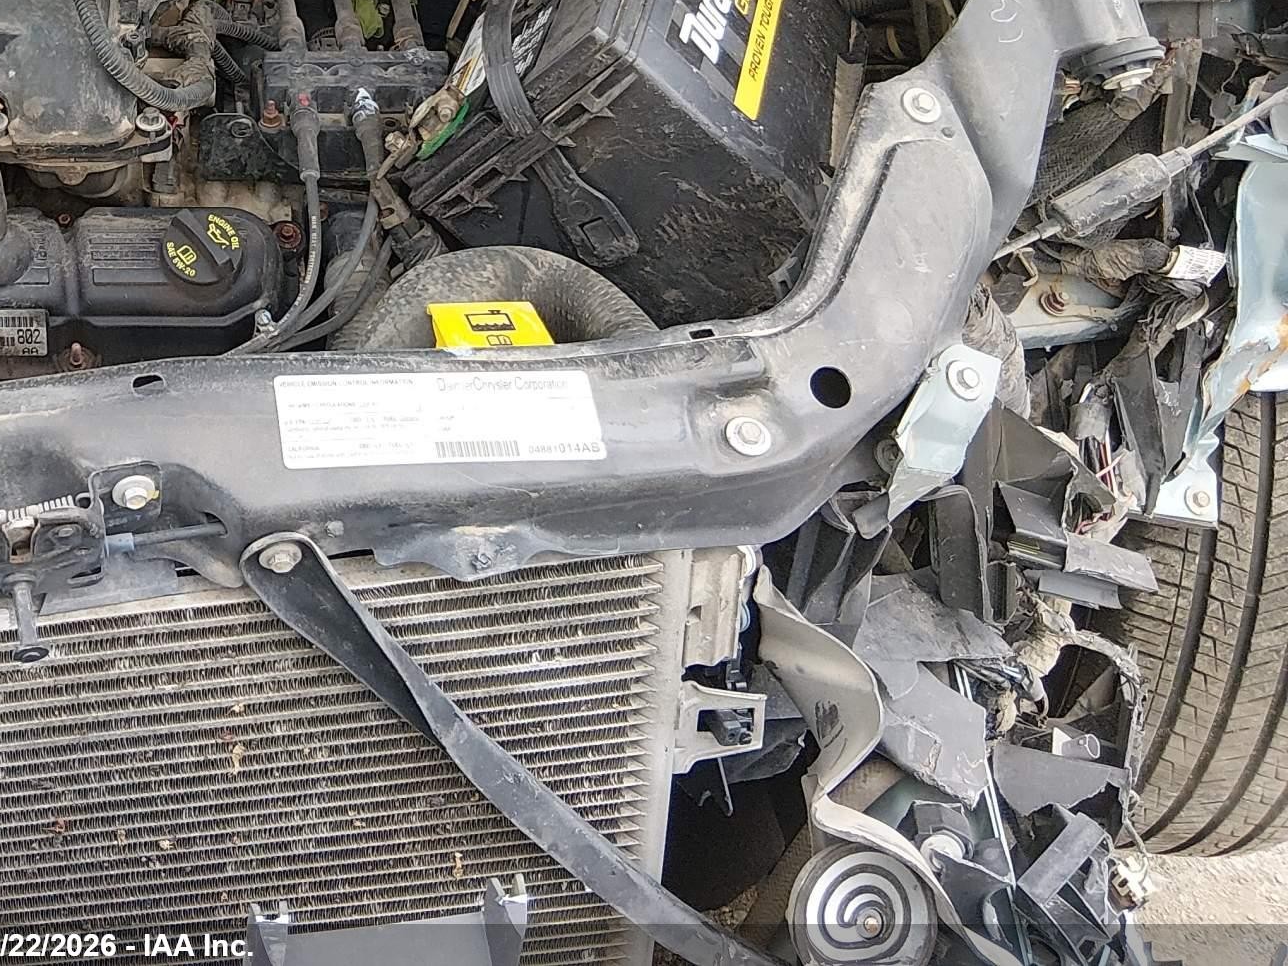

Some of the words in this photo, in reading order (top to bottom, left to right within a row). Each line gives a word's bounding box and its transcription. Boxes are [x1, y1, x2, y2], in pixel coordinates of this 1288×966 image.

[748, 26, 767, 82] PROVEN
[207, 214, 236, 236] ENGINE
[230, 236, 241, 250] OIL
[166, 241, 176, 259] SAE
[172, 258, 197, 278] 5W-20
[16, 328, 42, 345] 802
